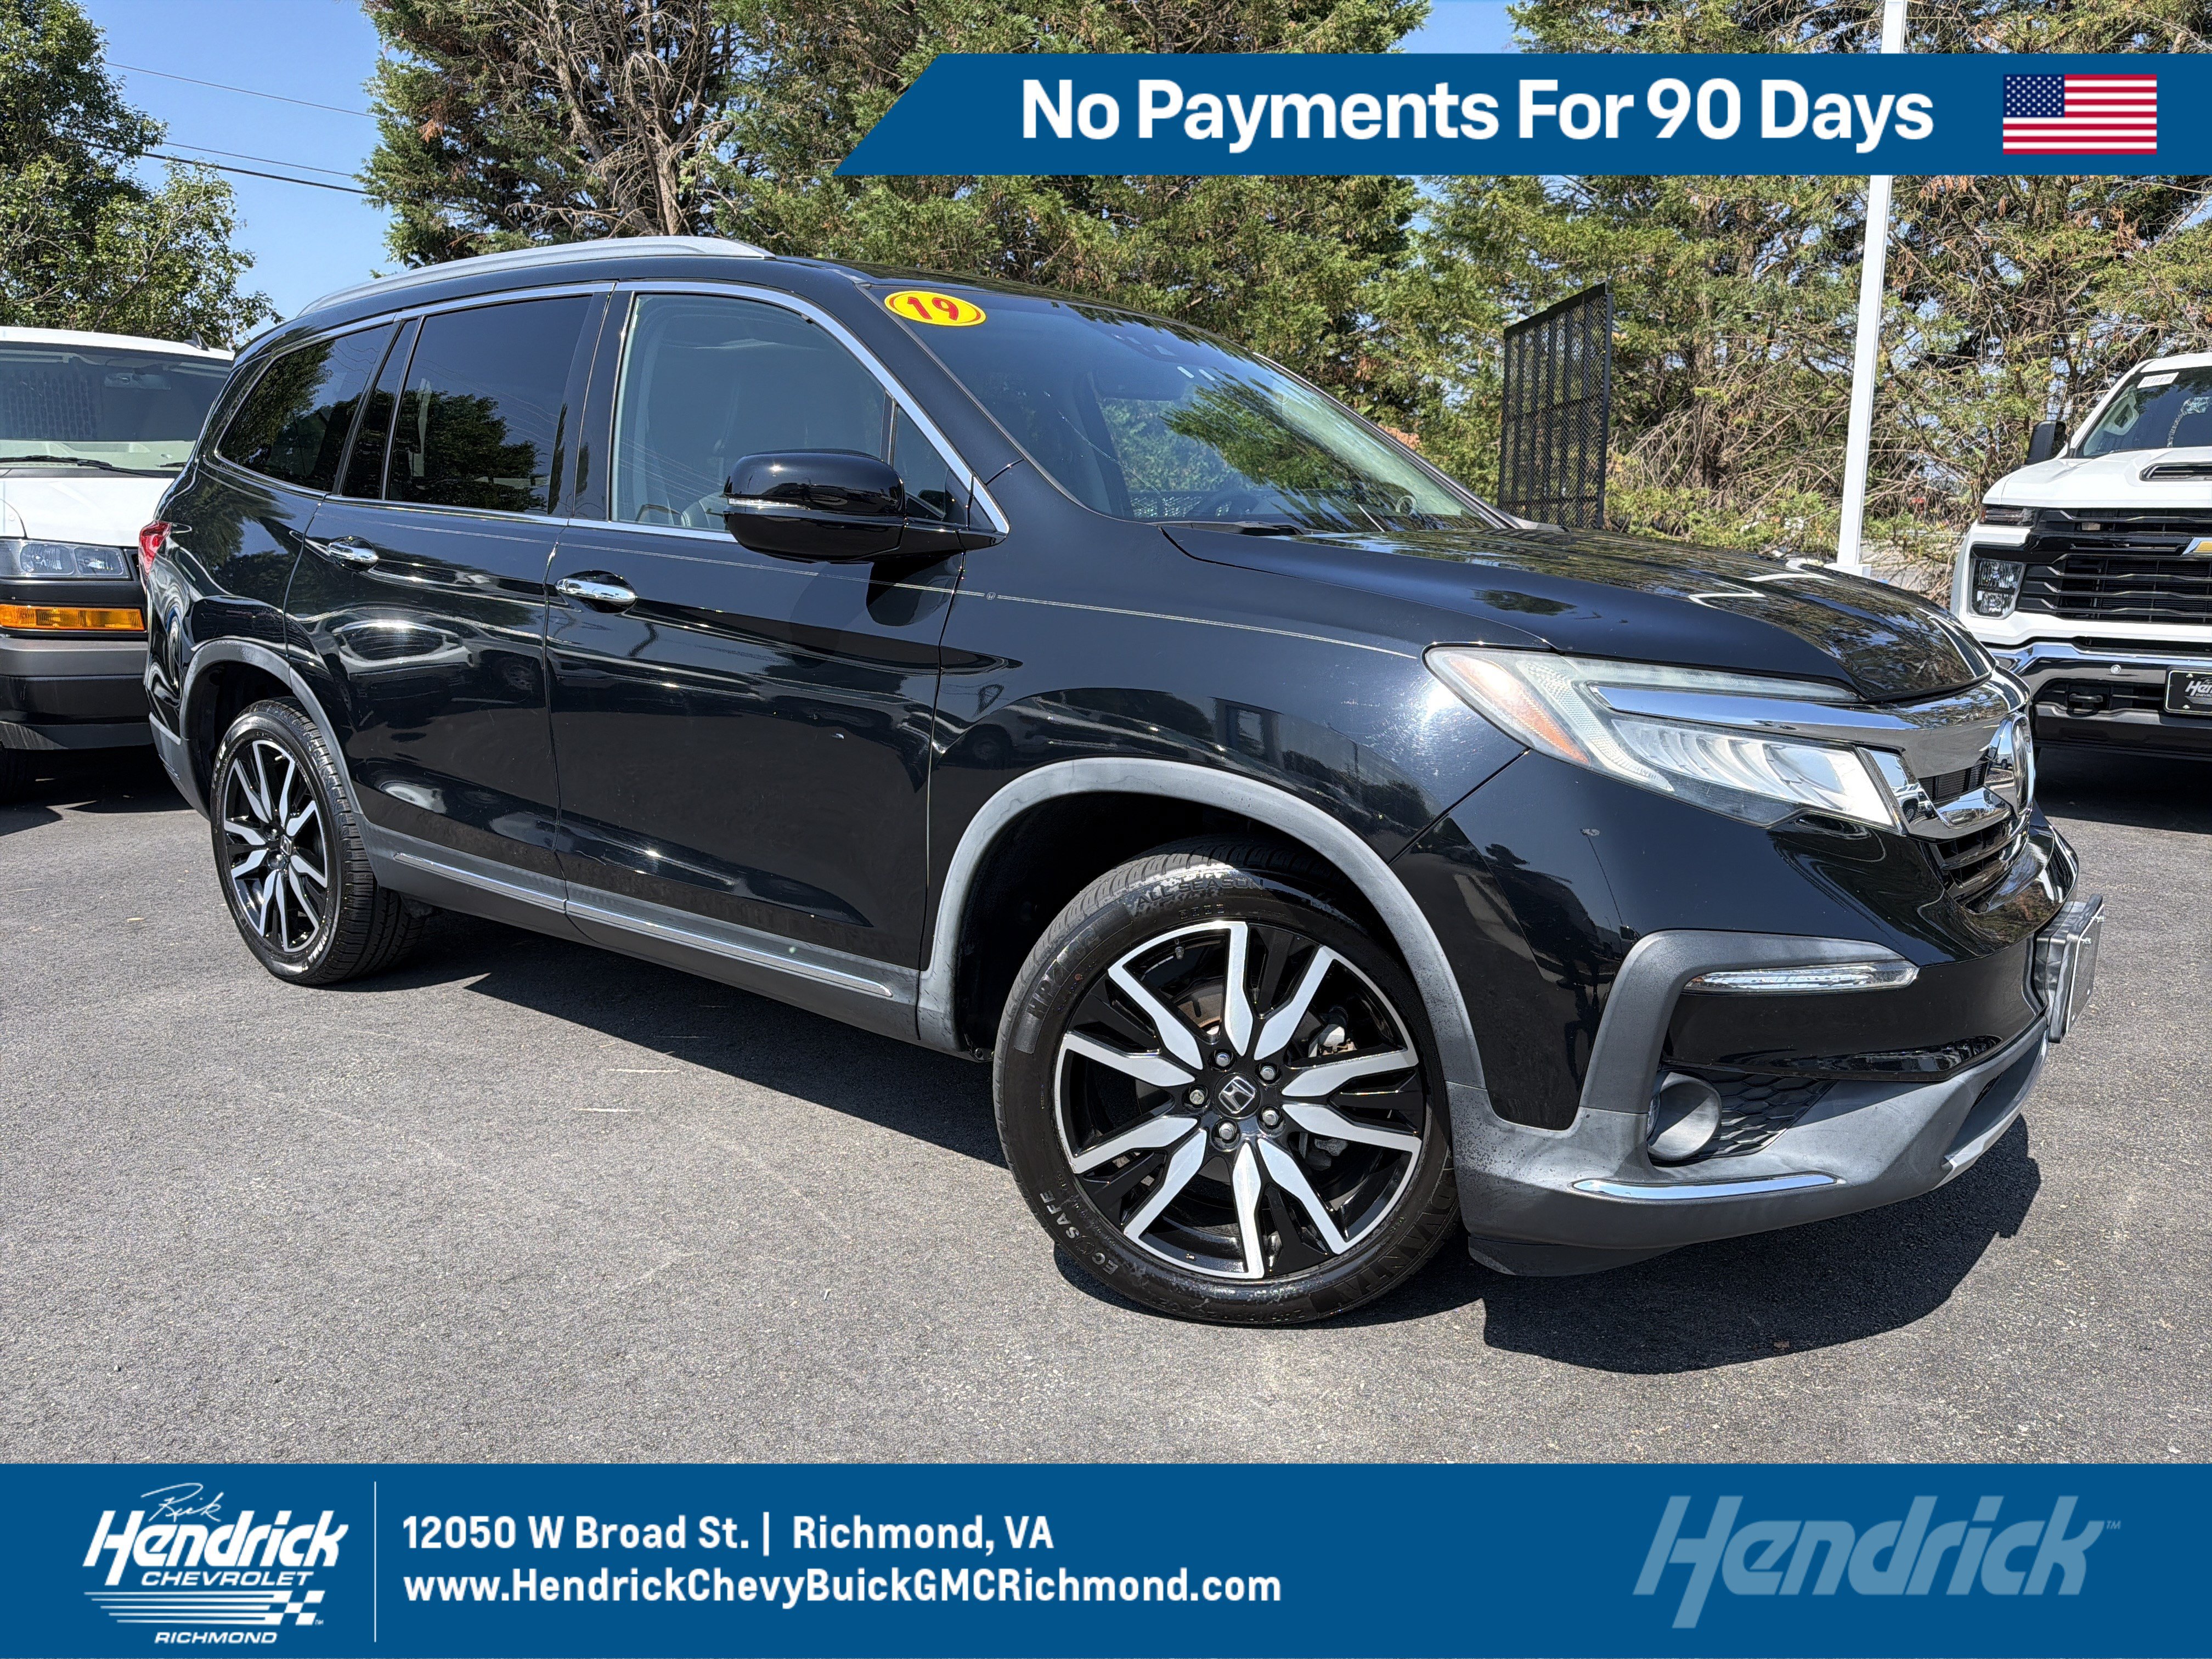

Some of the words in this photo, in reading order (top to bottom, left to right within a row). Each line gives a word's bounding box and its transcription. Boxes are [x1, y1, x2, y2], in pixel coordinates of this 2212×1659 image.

[906, 296, 960, 321] 19
[1136, 888, 1174, 906] ALL
[1179, 878, 1263, 894] SEASON
